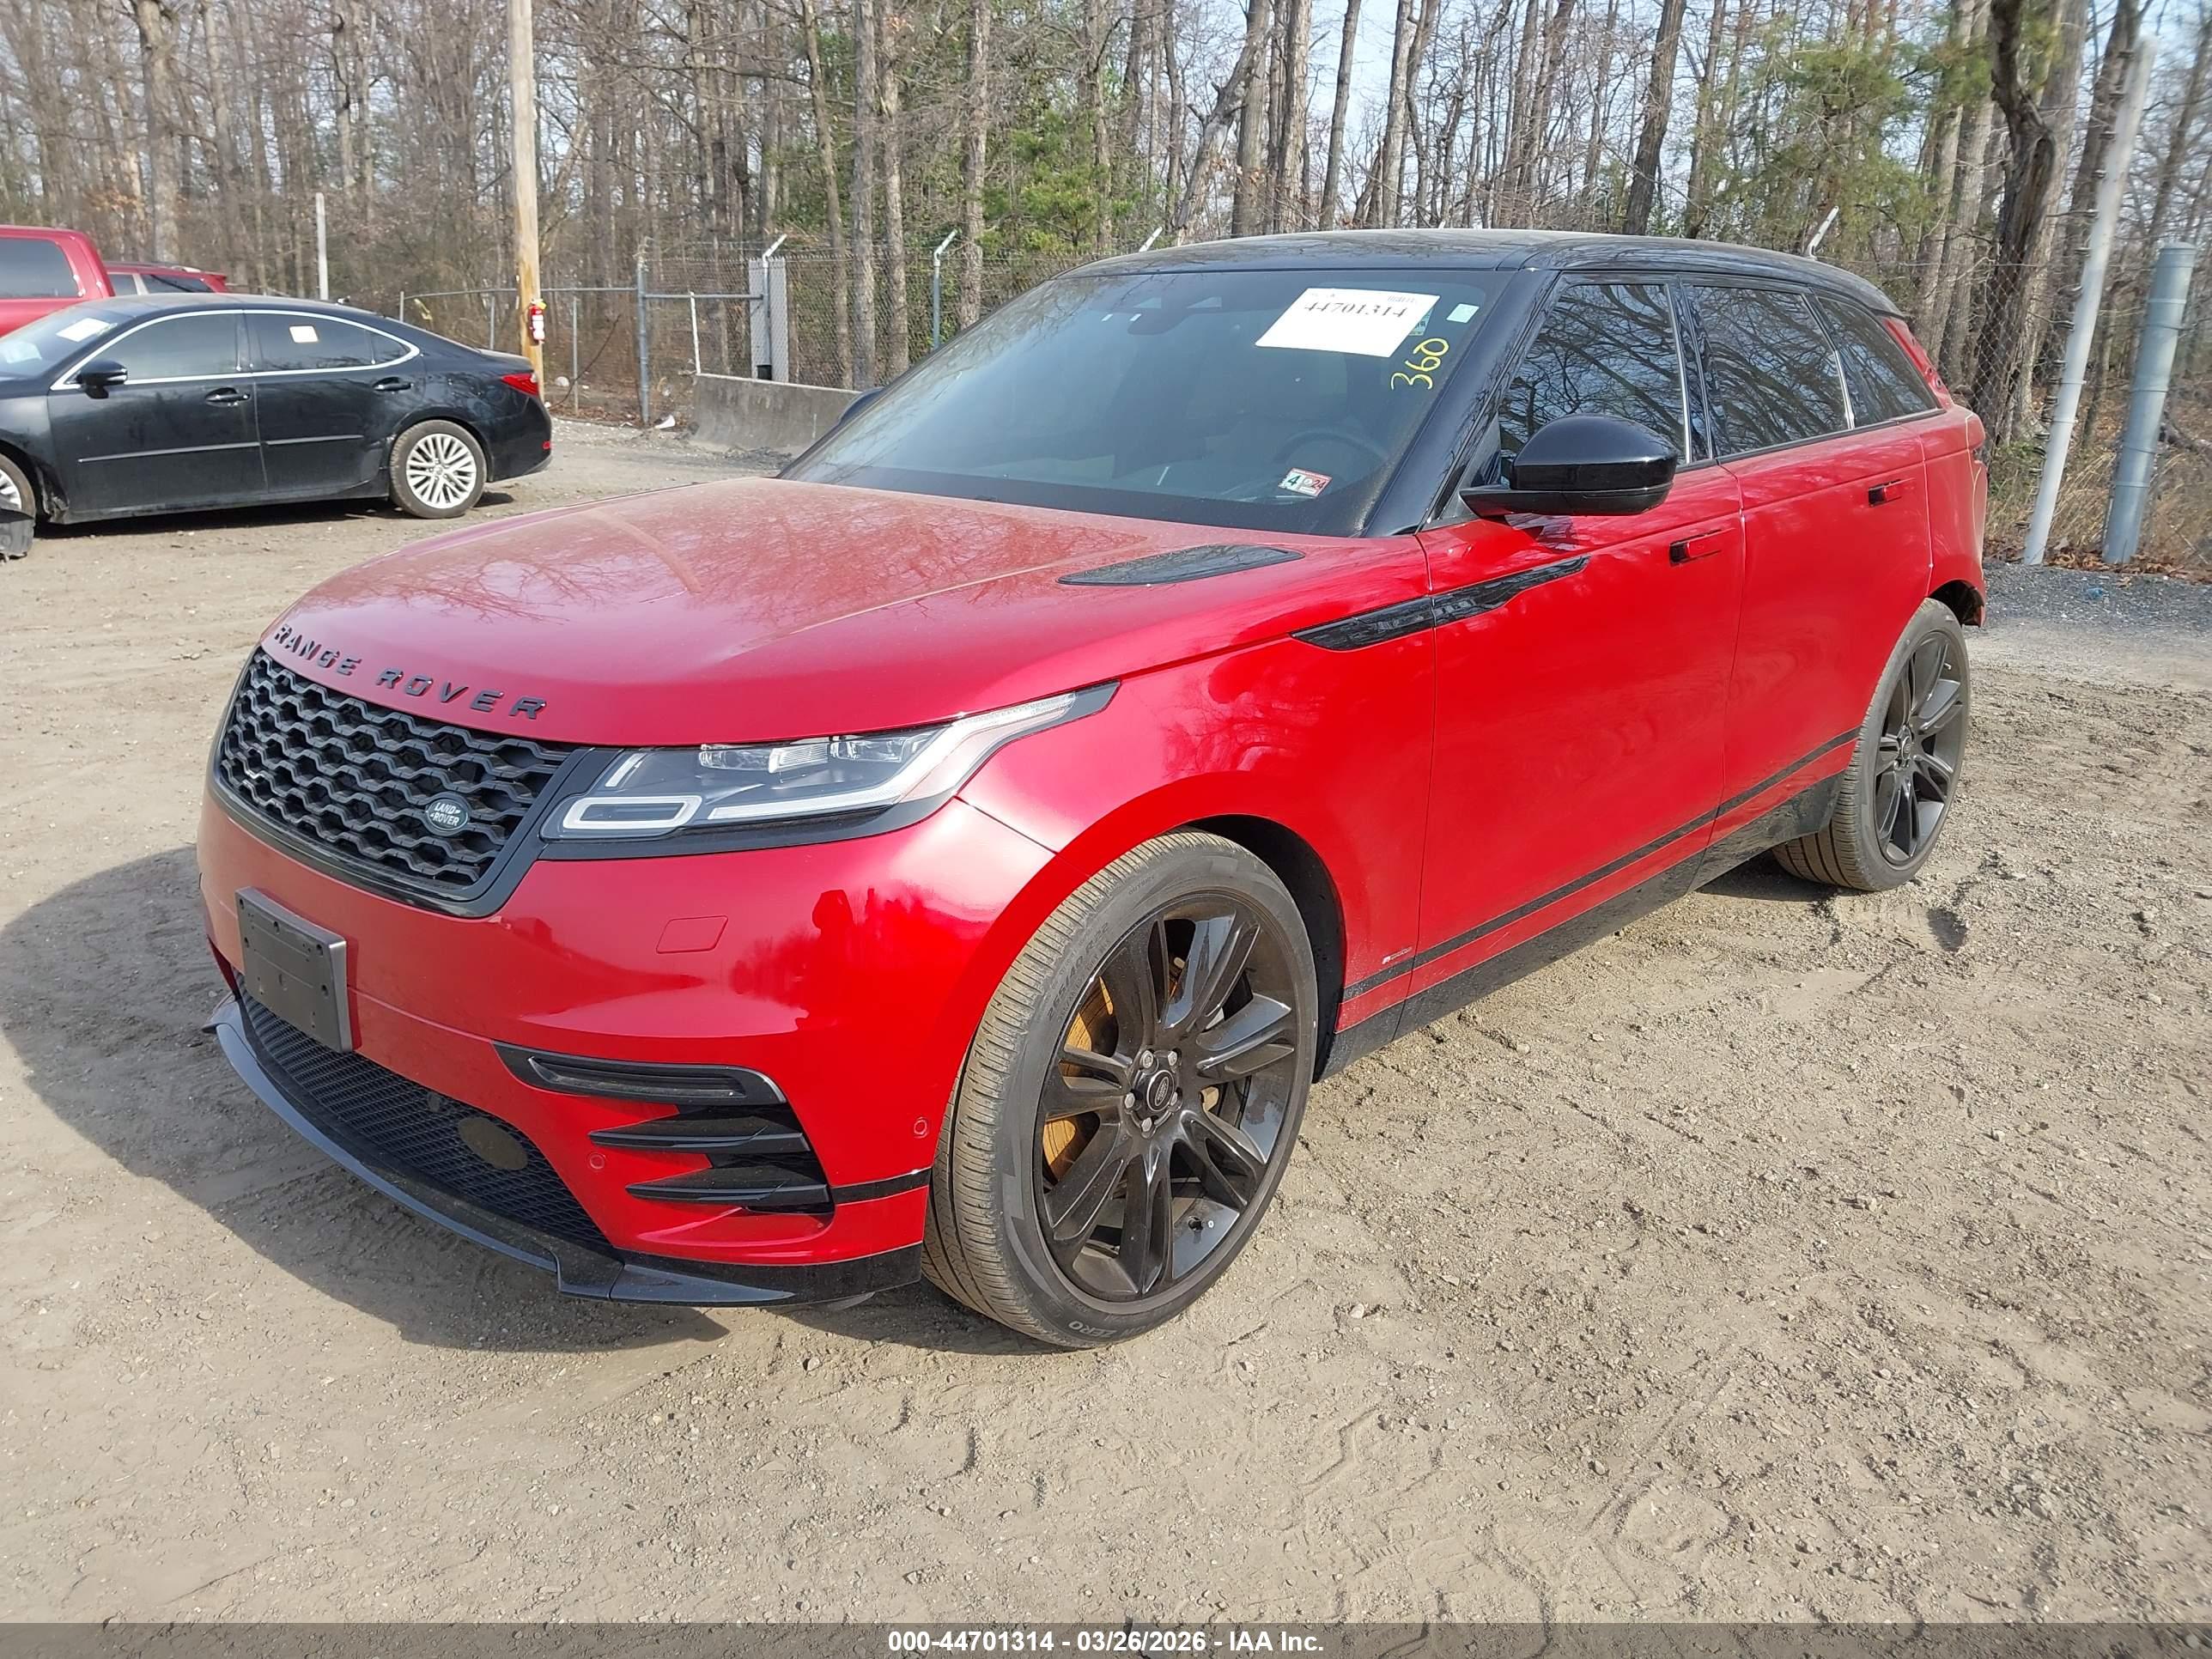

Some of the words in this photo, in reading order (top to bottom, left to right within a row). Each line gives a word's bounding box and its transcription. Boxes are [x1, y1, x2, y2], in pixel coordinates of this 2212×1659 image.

[1304, 301, 1408, 318] 44701314
[1390, 337, 1449, 390] 360
[1287, 475, 1302, 486] 4
[274, 623, 362, 677] RANGE
[376, 667, 547, 720] ROVER
[434, 802, 457, 815] LAND
[432, 811, 460, 826] ROVER
[1068, 1320, 1117, 1338] ZERO
